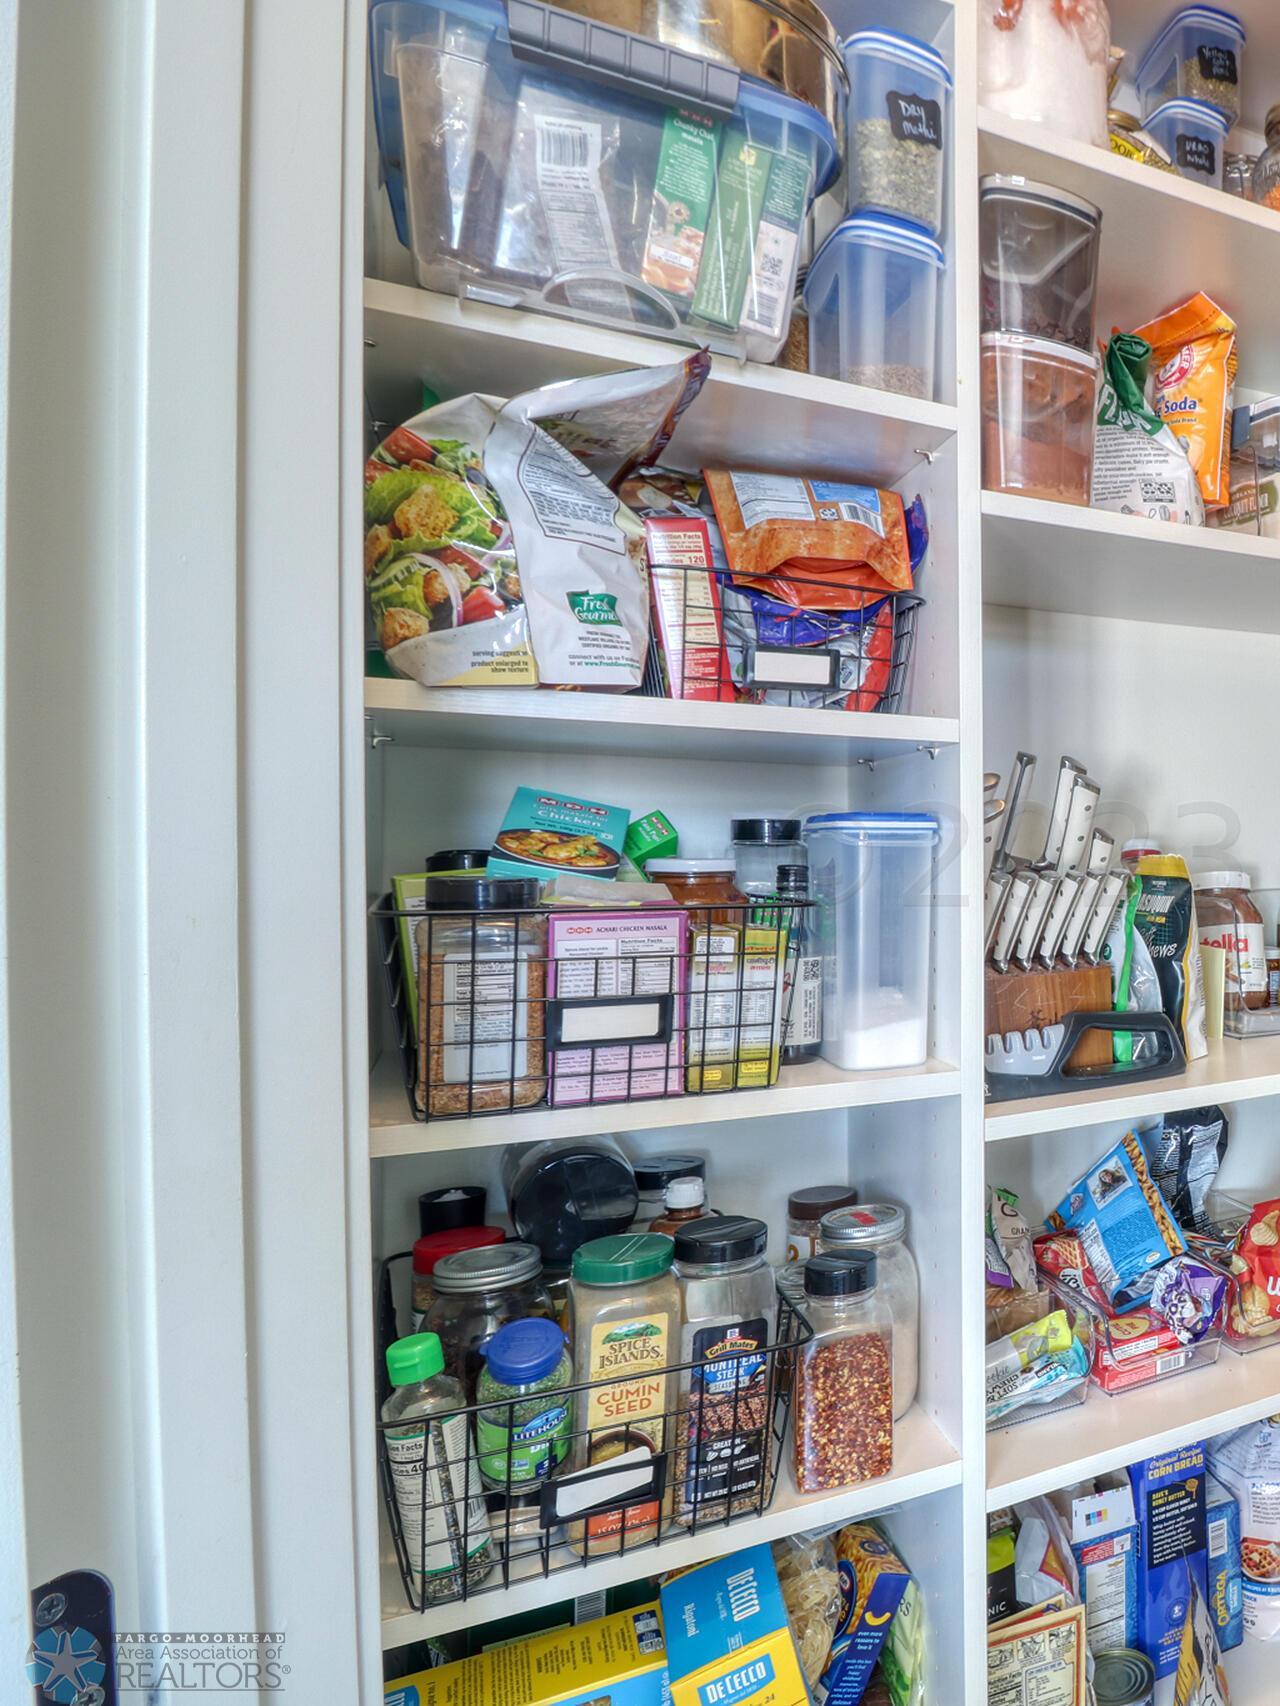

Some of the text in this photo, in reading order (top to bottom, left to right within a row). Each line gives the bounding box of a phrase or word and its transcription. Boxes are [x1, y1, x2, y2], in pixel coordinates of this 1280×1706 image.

[1164, 398, 1198, 414] Soda
[688, 556, 705, 564] 120
[471, 660, 492, 668] product
[493, 660, 520, 668] enlarged
[537, 809, 602, 828] Chicken
[1200, 933, 1249, 952] tella
[608, 1337, 652, 1356] SPICE
[709, 1341, 755, 1356] Grill Mates
[596, 1382, 661, 1406] CUMIN
[603, 1399, 652, 1418] SEED
[401, 1443, 423, 1451] Facts
[1148, 1454, 1204, 1480] CORN BREAD
[728, 1580, 761, 1622] CECCO
[1216, 1569, 1230, 1626] ORTEGA
[706, 1661, 767, 1704] DE CECCO
